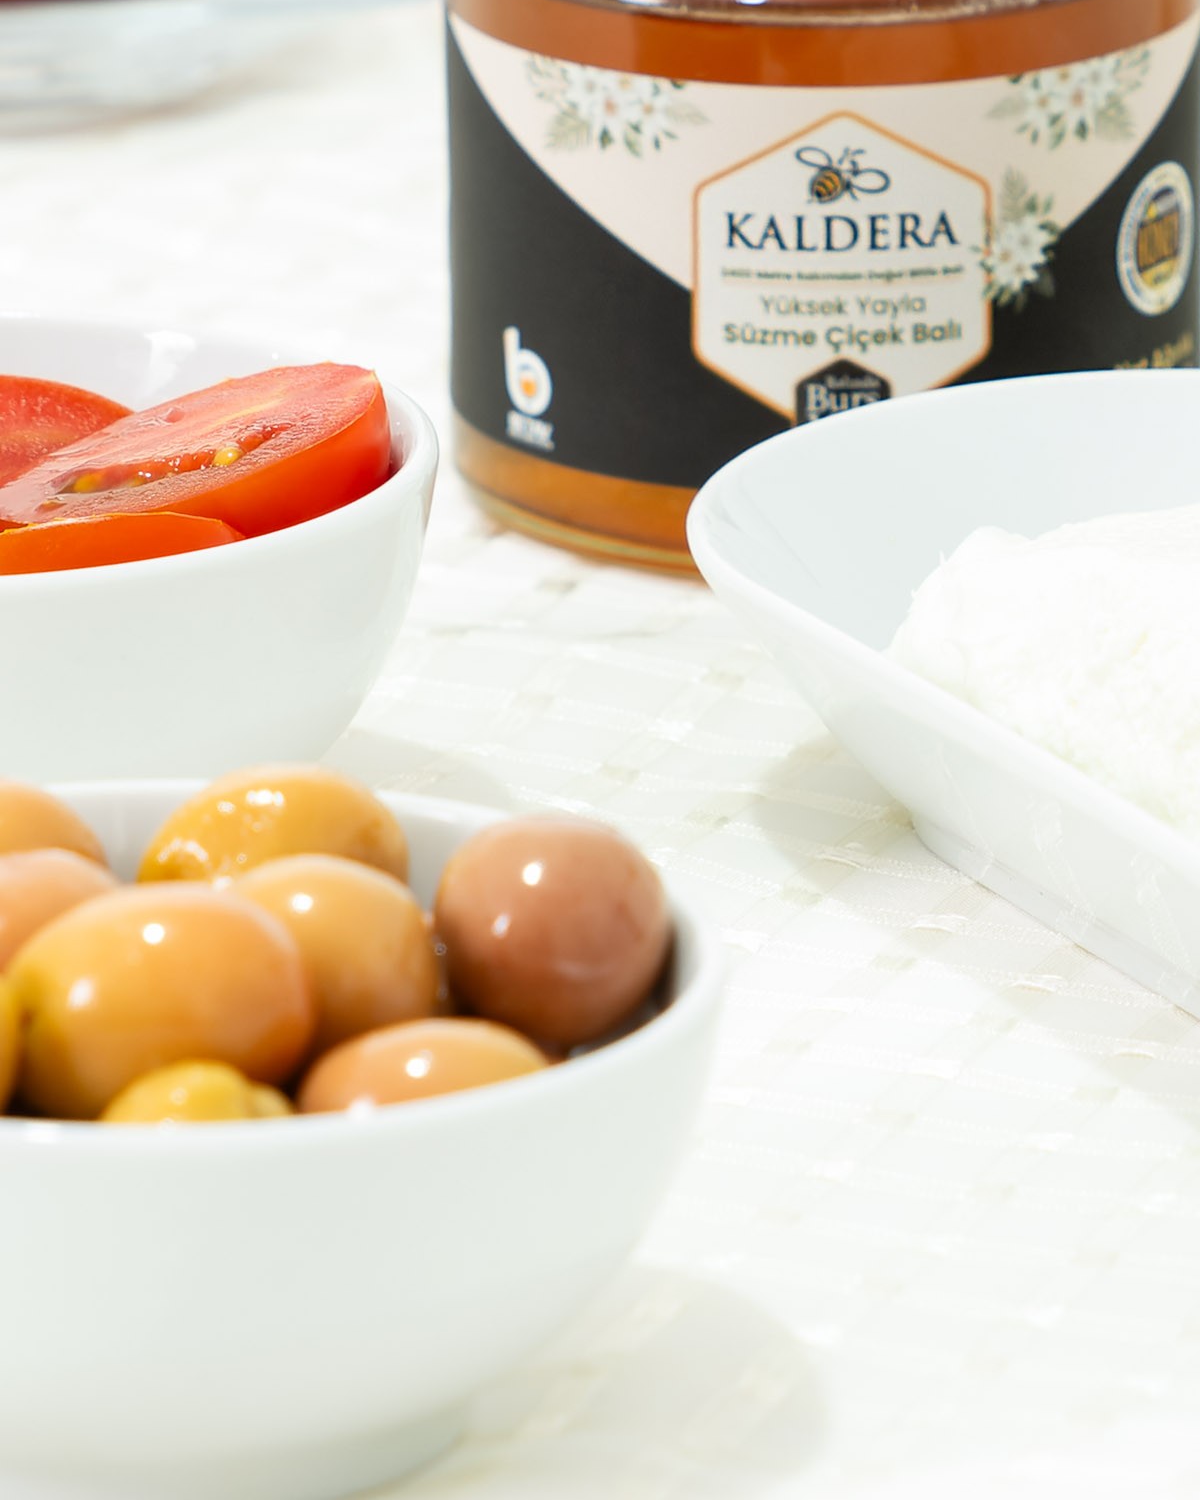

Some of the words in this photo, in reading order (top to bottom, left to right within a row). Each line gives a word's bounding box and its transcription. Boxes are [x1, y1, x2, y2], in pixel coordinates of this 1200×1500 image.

[724, 209, 960, 251] KALDERA
[760, 294, 848, 316] Yüksek
[856, 293, 927, 319] Yayla
[723, 322, 817, 346] Süzme
[825, 323, 905, 352] Çiçek
[912, 318, 963, 344] Balı
